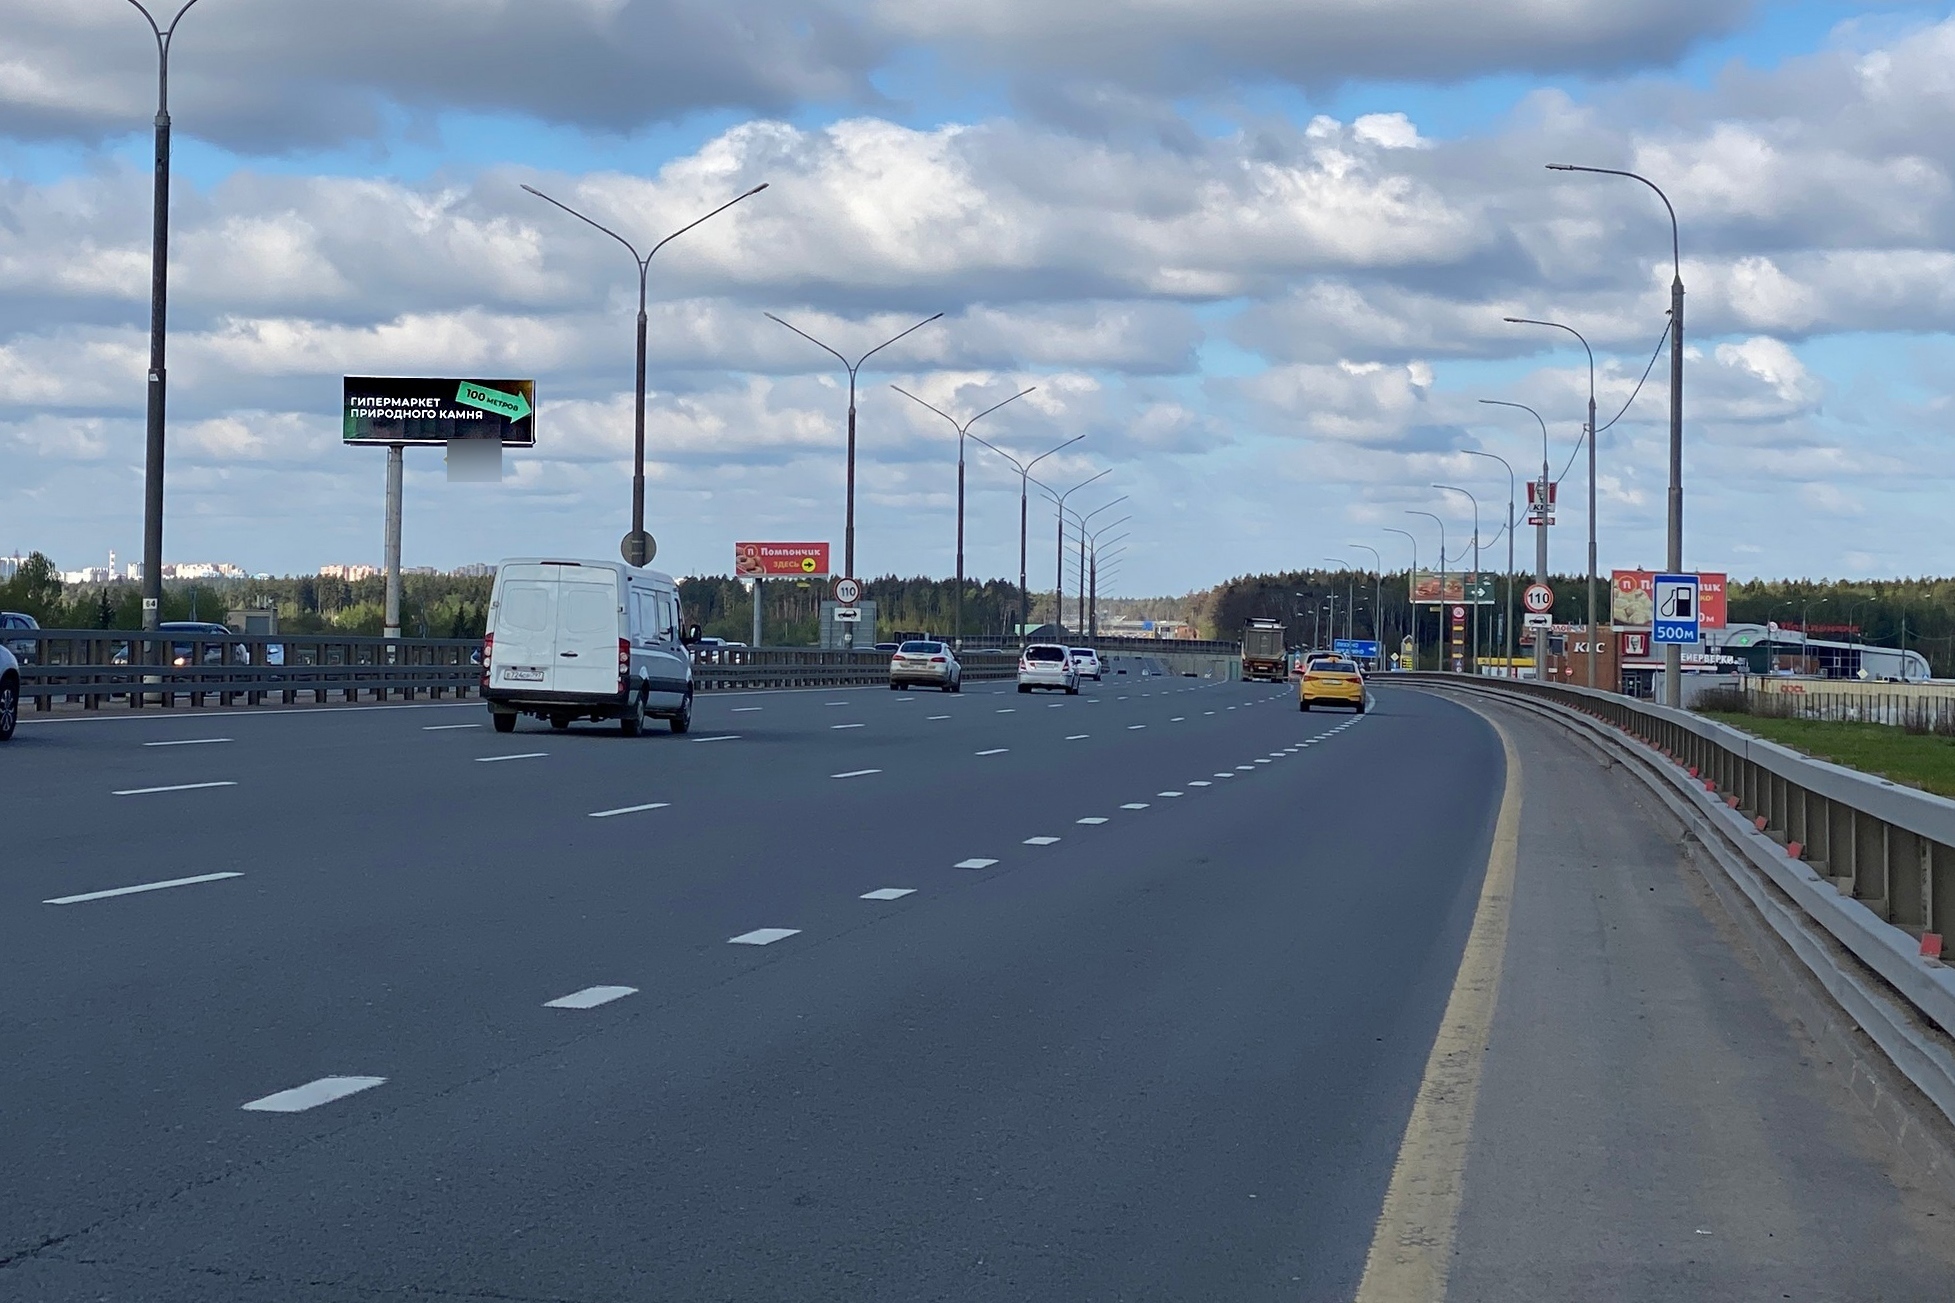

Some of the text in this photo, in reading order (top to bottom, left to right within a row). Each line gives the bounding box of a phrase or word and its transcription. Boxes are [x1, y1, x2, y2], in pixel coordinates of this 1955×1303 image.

[350, 397, 441, 408] ГИПЕРМАРКЕТ
[466, 388, 519, 412] 100 МЕТРОВ
[350, 408, 483, 420] ПРИРОДНОГО КАМНЯ
[760, 547, 821, 557] Помпончик
[773, 561, 799, 569] ЗДЕСЬ
[841, 586, 856, 597] 110
[145, 600, 156, 608] 64
[1528, 593, 1550, 604] 110
[1681, 652, 1734, 665] ЕЙЕРВЕРКИ
